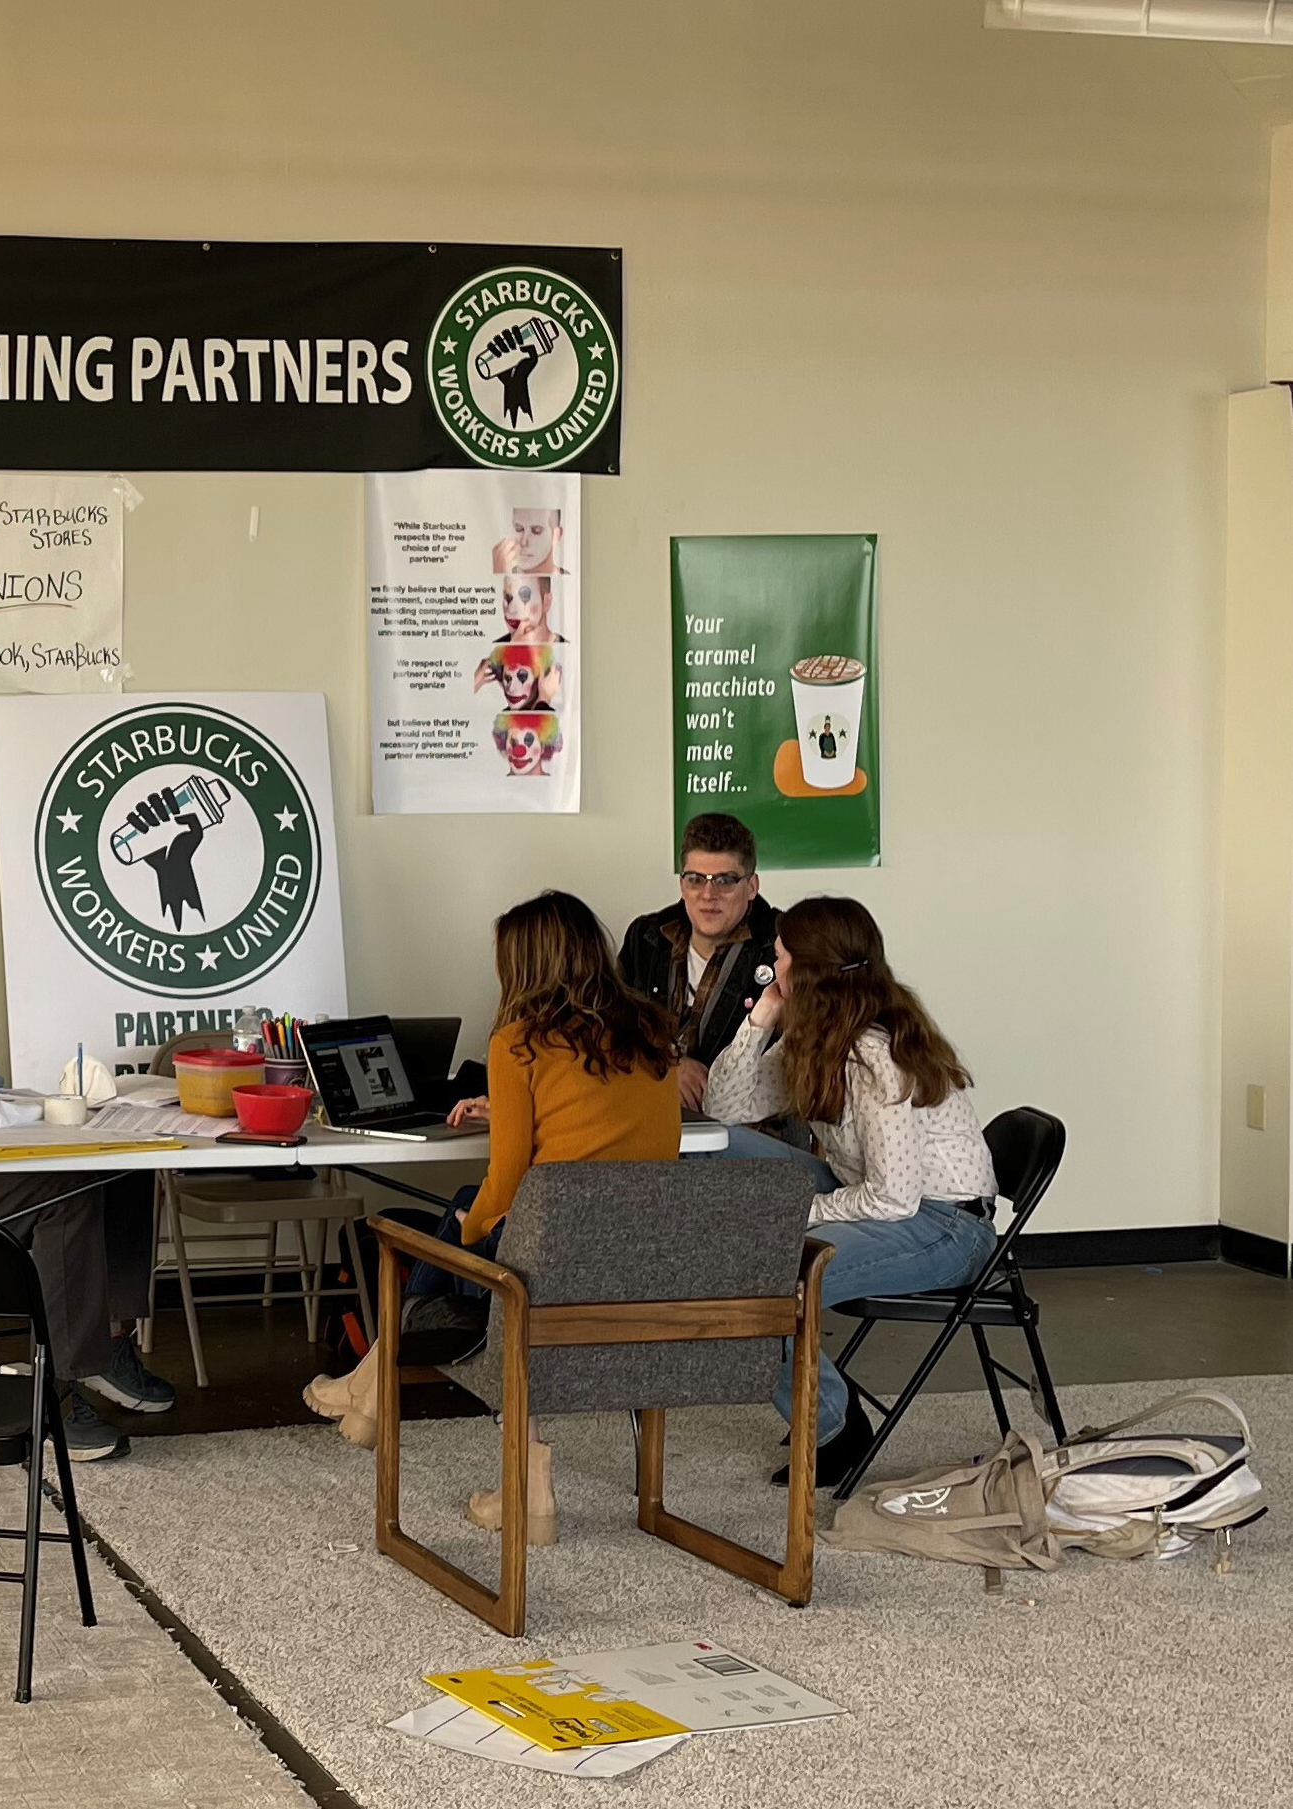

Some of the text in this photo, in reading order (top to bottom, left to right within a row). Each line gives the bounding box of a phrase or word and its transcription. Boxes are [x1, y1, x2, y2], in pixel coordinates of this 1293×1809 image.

[456, 280, 594, 338] STARBUCKS
[130, 336, 413, 405] PARTNERS
[438, 364, 607, 458] WORKERS UNITED
[423, 522, 466, 530] Starbucks
[394, 533, 465, 542] respects the free
[402, 544, 429, 552] choice
[432, 544, 440, 552] of
[408, 585, 437, 593] believe
[439, 585, 455, 593] that
[475, 585, 495, 593] work
[425, 596, 458, 605] coupled
[460, 596, 478, 604] with
[419, 607, 477, 616] compensation
[479, 607, 496, 615] and
[421, 618, 448, 626] makes
[451, 618, 478, 626] unions
[685, 614, 724, 634] Your
[685, 643, 756, 666] caramel
[411, 660, 443, 668] respect
[432, 671, 452, 679] right
[410, 682, 446, 690] organize
[685, 675, 775, 698] macchiato
[686, 707, 735, 729] won't
[387, 719, 470, 728] but believe that they
[395, 730, 461, 738] would not find it
[421, 741, 444, 750] given
[687, 739, 733, 762] make
[385, 752, 413, 760] partner
[76, 724, 268, 798] STARBUCKS
[687, 771, 748, 793] itself...
[56, 853, 302, 973] WORKERS UNITED
[115, 1007, 273, 1047] PARTNE
